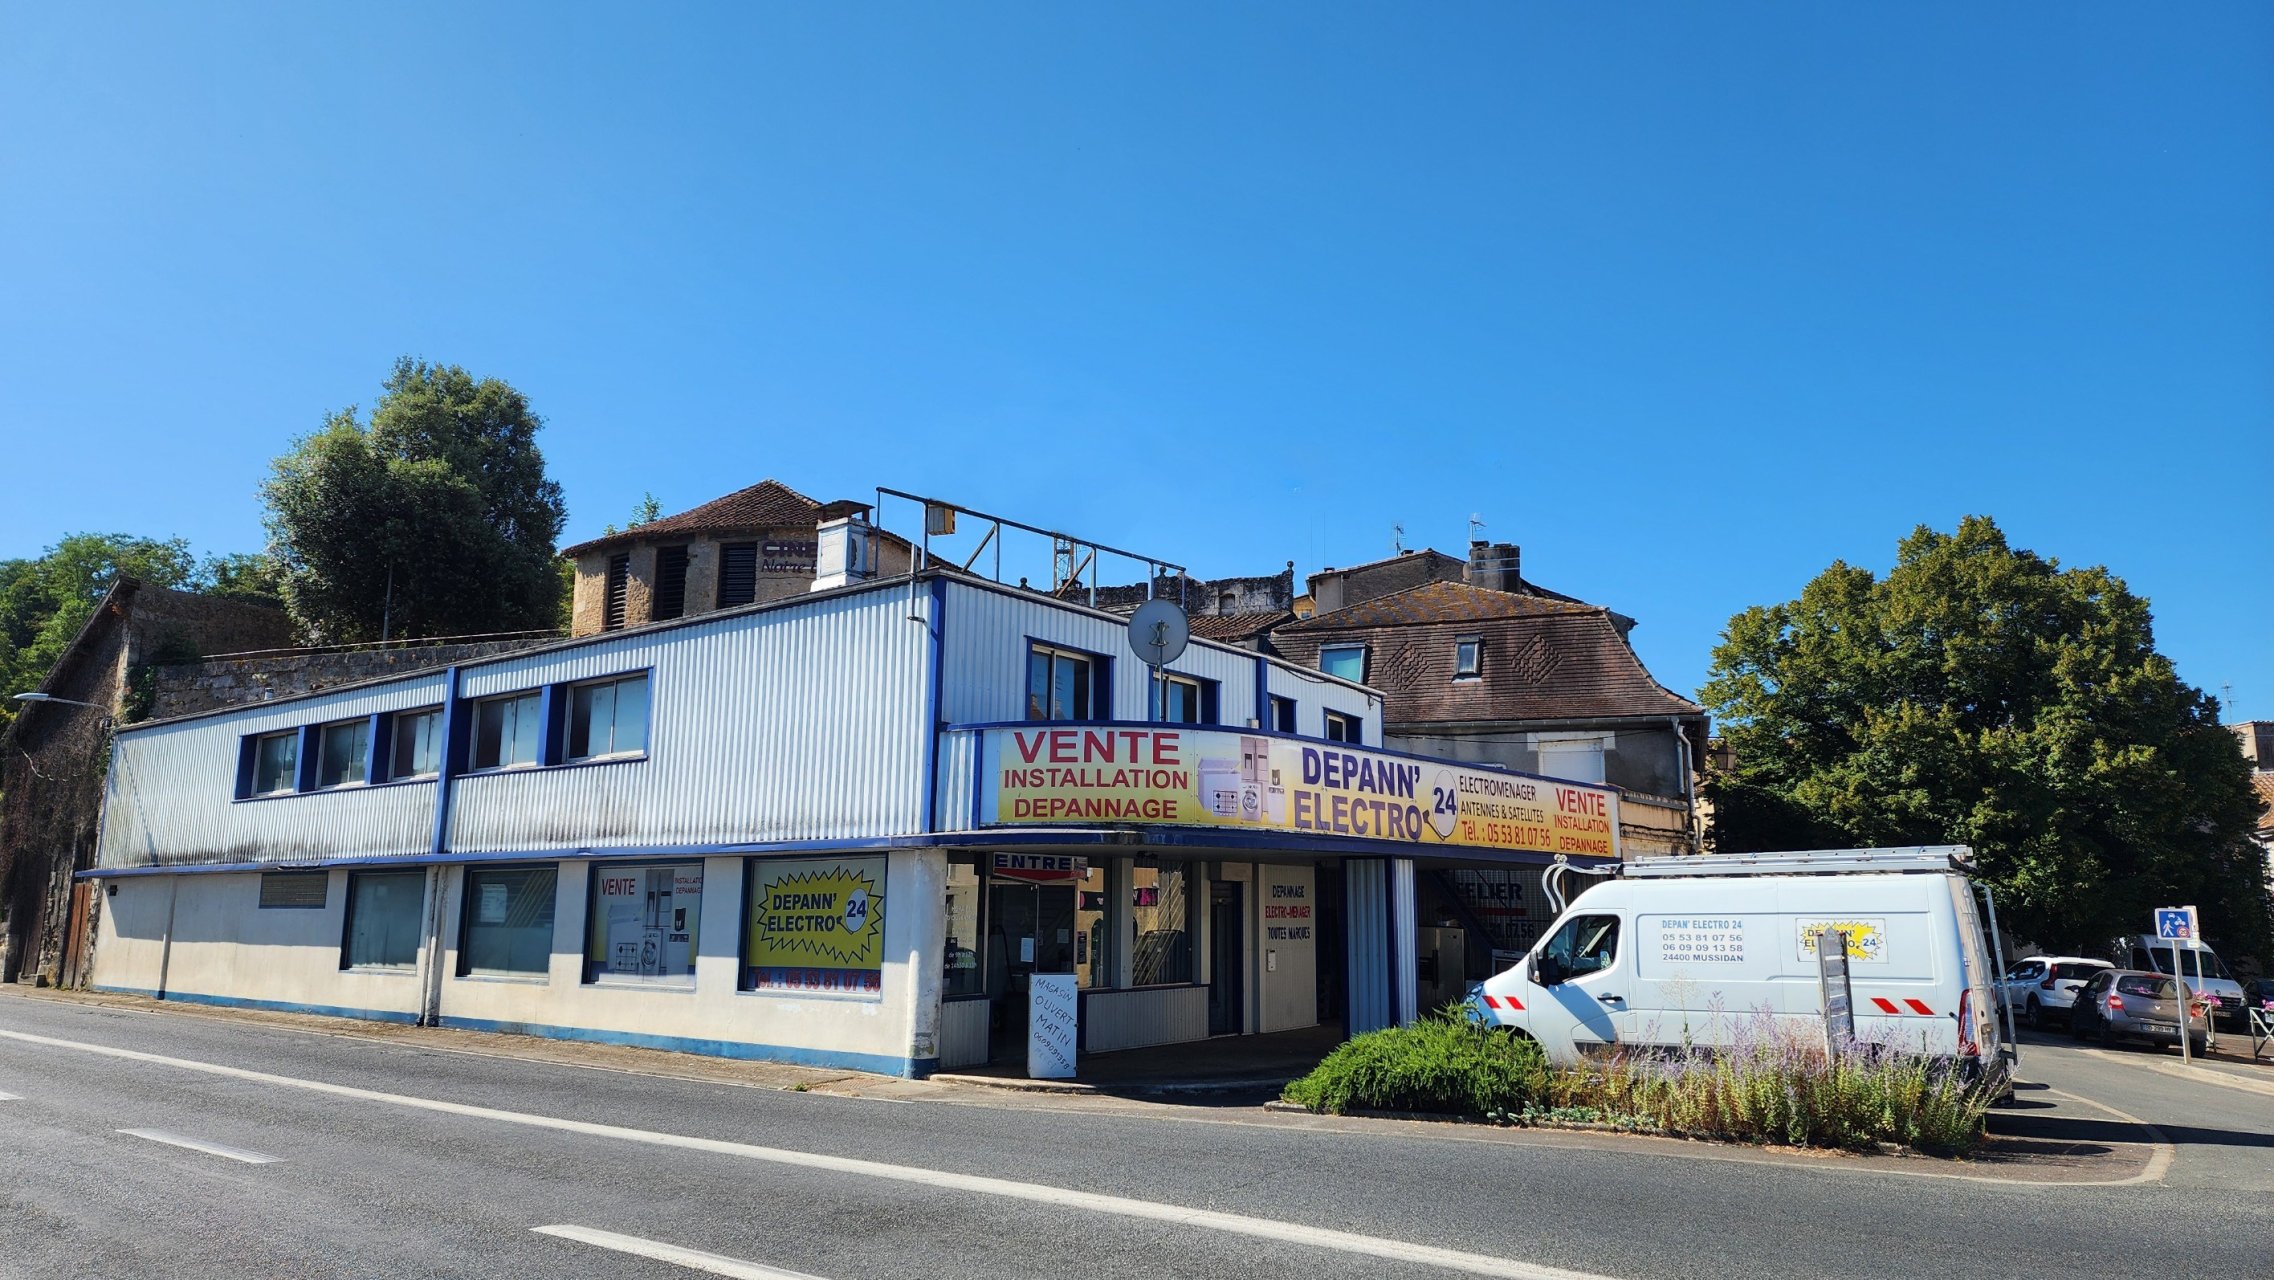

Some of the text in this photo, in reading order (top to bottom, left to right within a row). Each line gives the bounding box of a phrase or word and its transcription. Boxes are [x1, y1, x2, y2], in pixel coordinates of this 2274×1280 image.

[761, 559, 807, 574] Notre
[1014, 731, 1180, 765] VENTE
[1004, 768, 1188, 790] INSTALLATION
[1302, 747, 1420, 799] DEPANN'
[1459, 775, 1537, 802] ELECTROMENAGER
[1014, 798, 1178, 819] DEPANNAGE
[1434, 787, 1457, 816] 24
[1556, 787, 1607, 817] VENTE
[1294, 790, 1422, 840] ELECTRO
[1460, 801, 1544, 824] ANTENNES & SATELLITES
[1554, 814, 1609, 834] INSTALLATION
[1487, 823, 1499, 843] 05
[1502, 824, 1513, 844] 53
[1515, 825, 1526, 845] 81
[1527, 827, 1538, 846] 07
[1540, 828, 1550, 847] 56
[1559, 835, 1608, 854] DEPANNAGE
[601, 878, 636, 896] VENTE
[1272, 884, 1305, 899] DEPANNAGE
[772, 892, 837, 911] DEPANN'
[846, 899, 867, 918] 24
[1265, 905, 1311, 919] ELECTRO-MENAGER
[767, 914, 836, 932] ELECTRO
[1662, 919, 1742, 930] DEPAN' ELECTRO 24
[1268, 926, 1311, 941] TOUTES MARQUES
[1662, 933, 1743, 943] 05 53 81 07 56
[1862, 938, 1877, 947] 24
[1662, 943, 1743, 953] 06 09 09 13 58
[1662, 953, 1744, 962] 24400 MUSSIDAN
[785, 969, 801, 989] 05
[823, 971, 839, 991] 81
[843, 972, 860, 992] 07
[1035, 995, 1075, 1025] OUVERT
[1033, 1031, 1070, 1070] 0609091358
